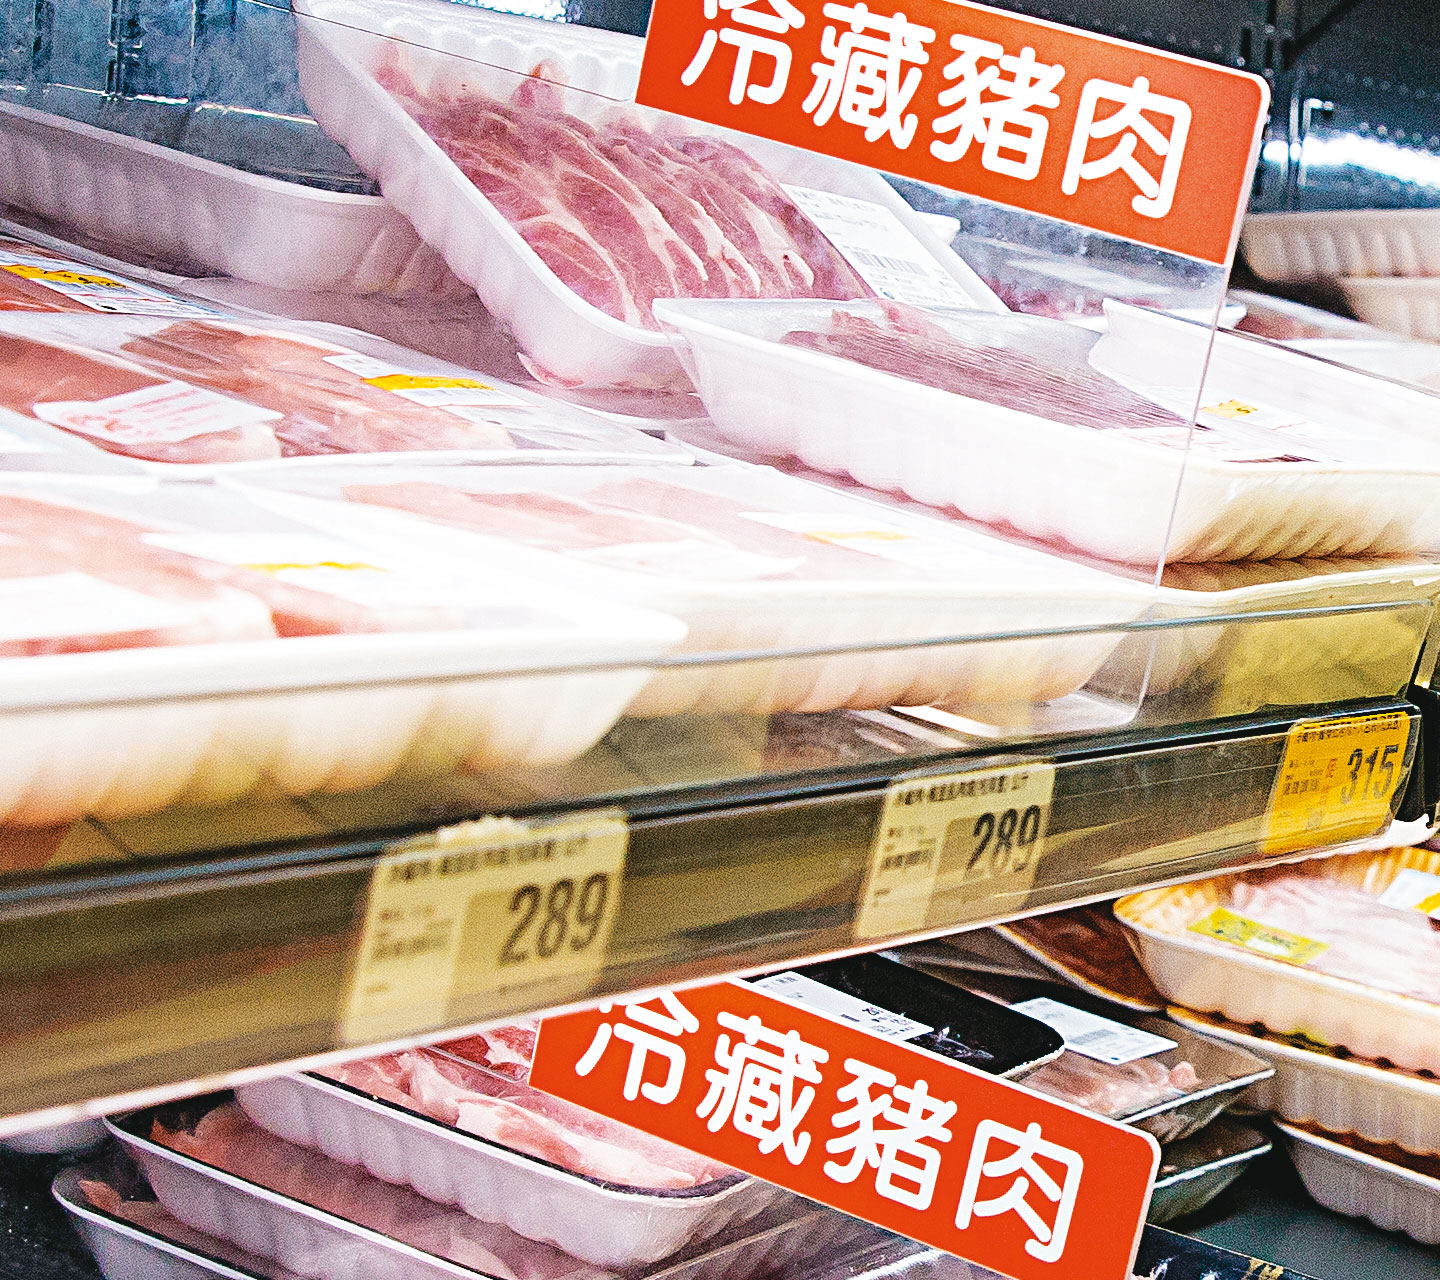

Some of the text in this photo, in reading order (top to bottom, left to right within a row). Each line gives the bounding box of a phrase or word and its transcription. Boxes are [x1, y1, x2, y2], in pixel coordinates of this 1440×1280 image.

[1340, 743, 1401, 806] 315
[963, 804, 1041, 880] 289
[499, 875, 612, 966] 289
[574, 997, 1085, 1264] 冷藏豬肉
